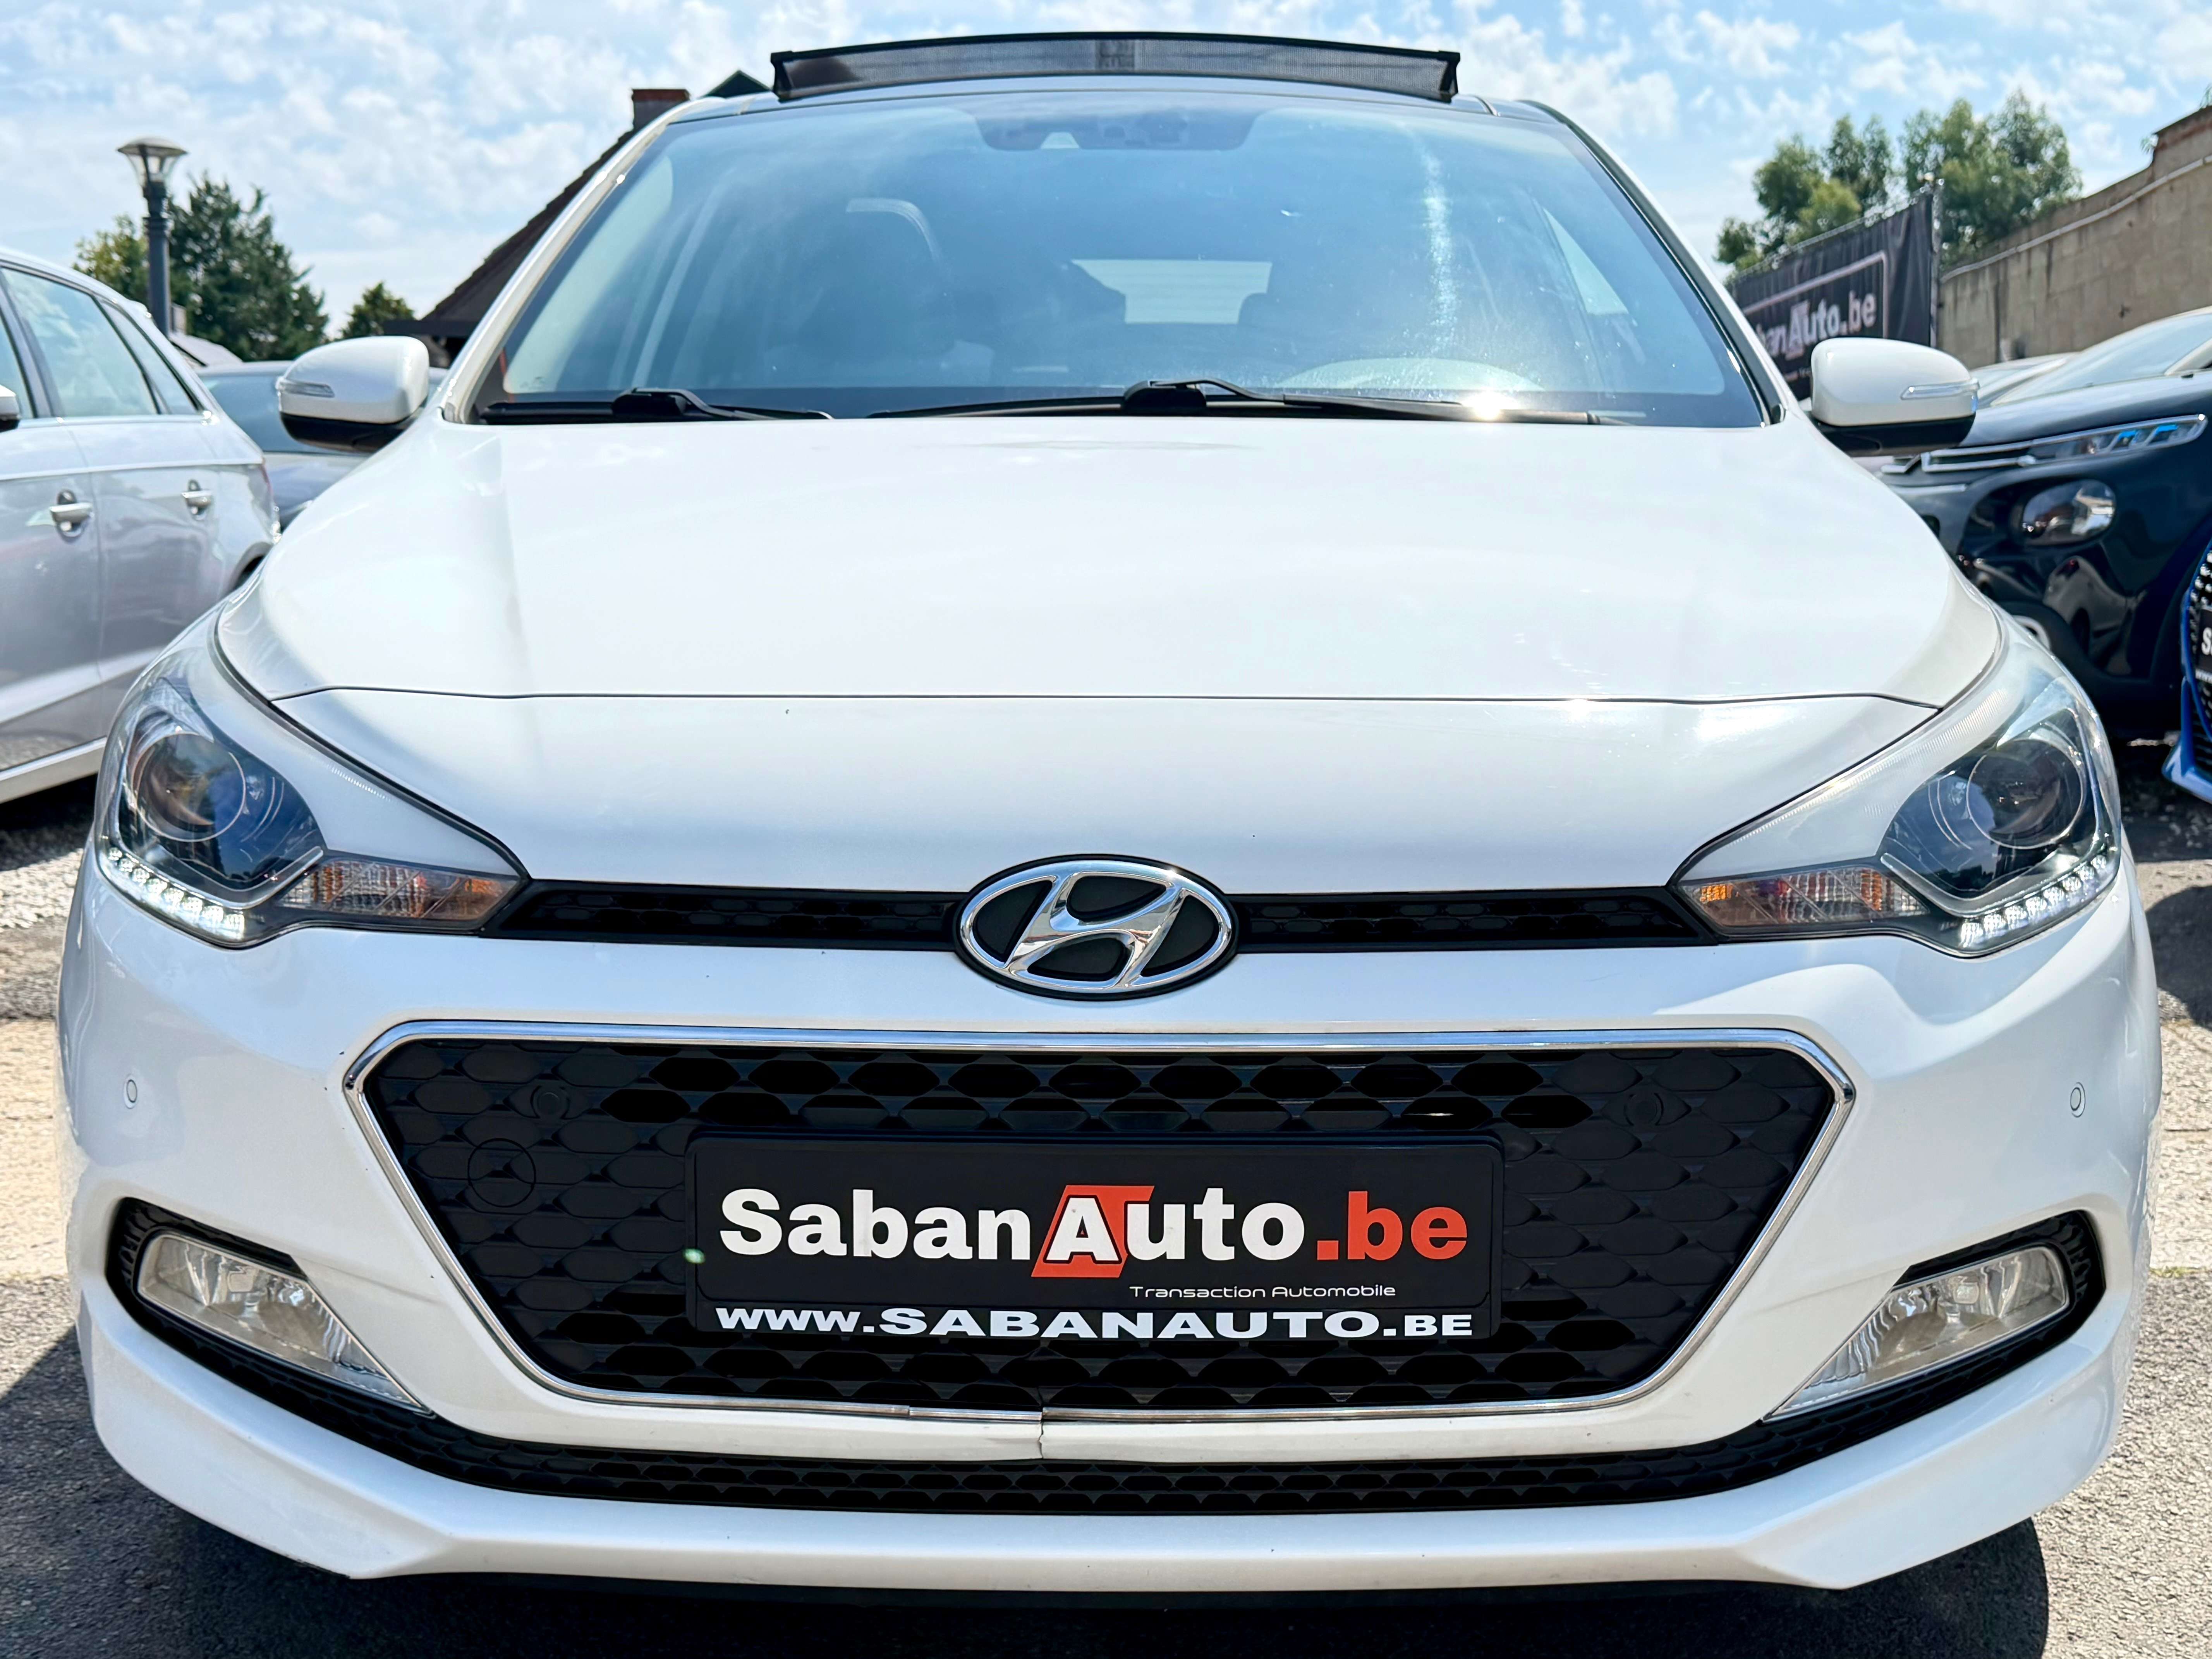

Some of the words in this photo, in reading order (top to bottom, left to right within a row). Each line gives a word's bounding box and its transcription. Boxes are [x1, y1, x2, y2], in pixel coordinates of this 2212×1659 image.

[720, 1185, 1468, 1277] SabanAuto.be
[1129, 1286, 1266, 1298] Transaction
[1272, 1284, 1396, 1298] Automobile
